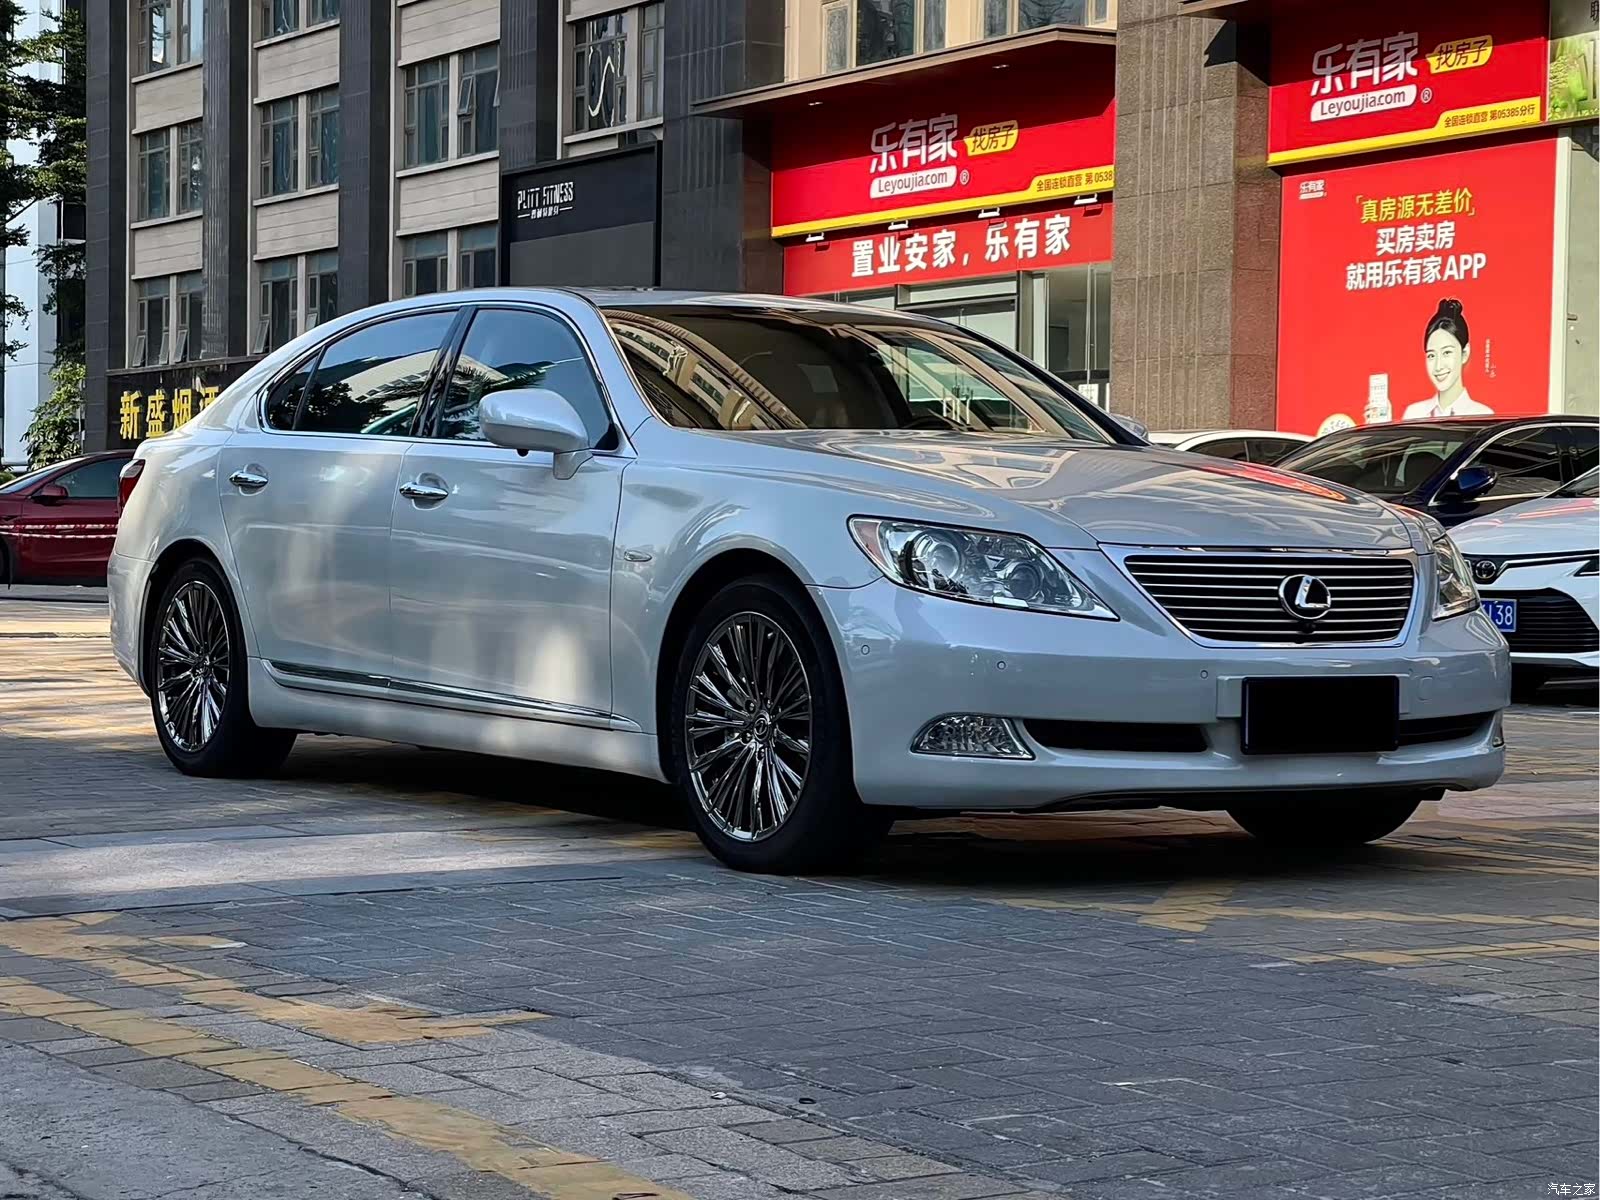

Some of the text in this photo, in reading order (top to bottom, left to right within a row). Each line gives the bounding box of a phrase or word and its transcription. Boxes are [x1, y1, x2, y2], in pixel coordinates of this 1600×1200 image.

[1310, 31, 1418, 97] 乐有家
[1434, 39, 1487, 71] 找房子
[1320, 90, 1406, 116] Leyoujia.com
[870, 113, 958, 174] 乐有家
[971, 126, 1015, 153] 找房子
[542, 181, 574, 206] FITNESS
[878, 171, 948, 194] Leyoujia.com
[1375, 220, 1456, 257] 买房卖房
